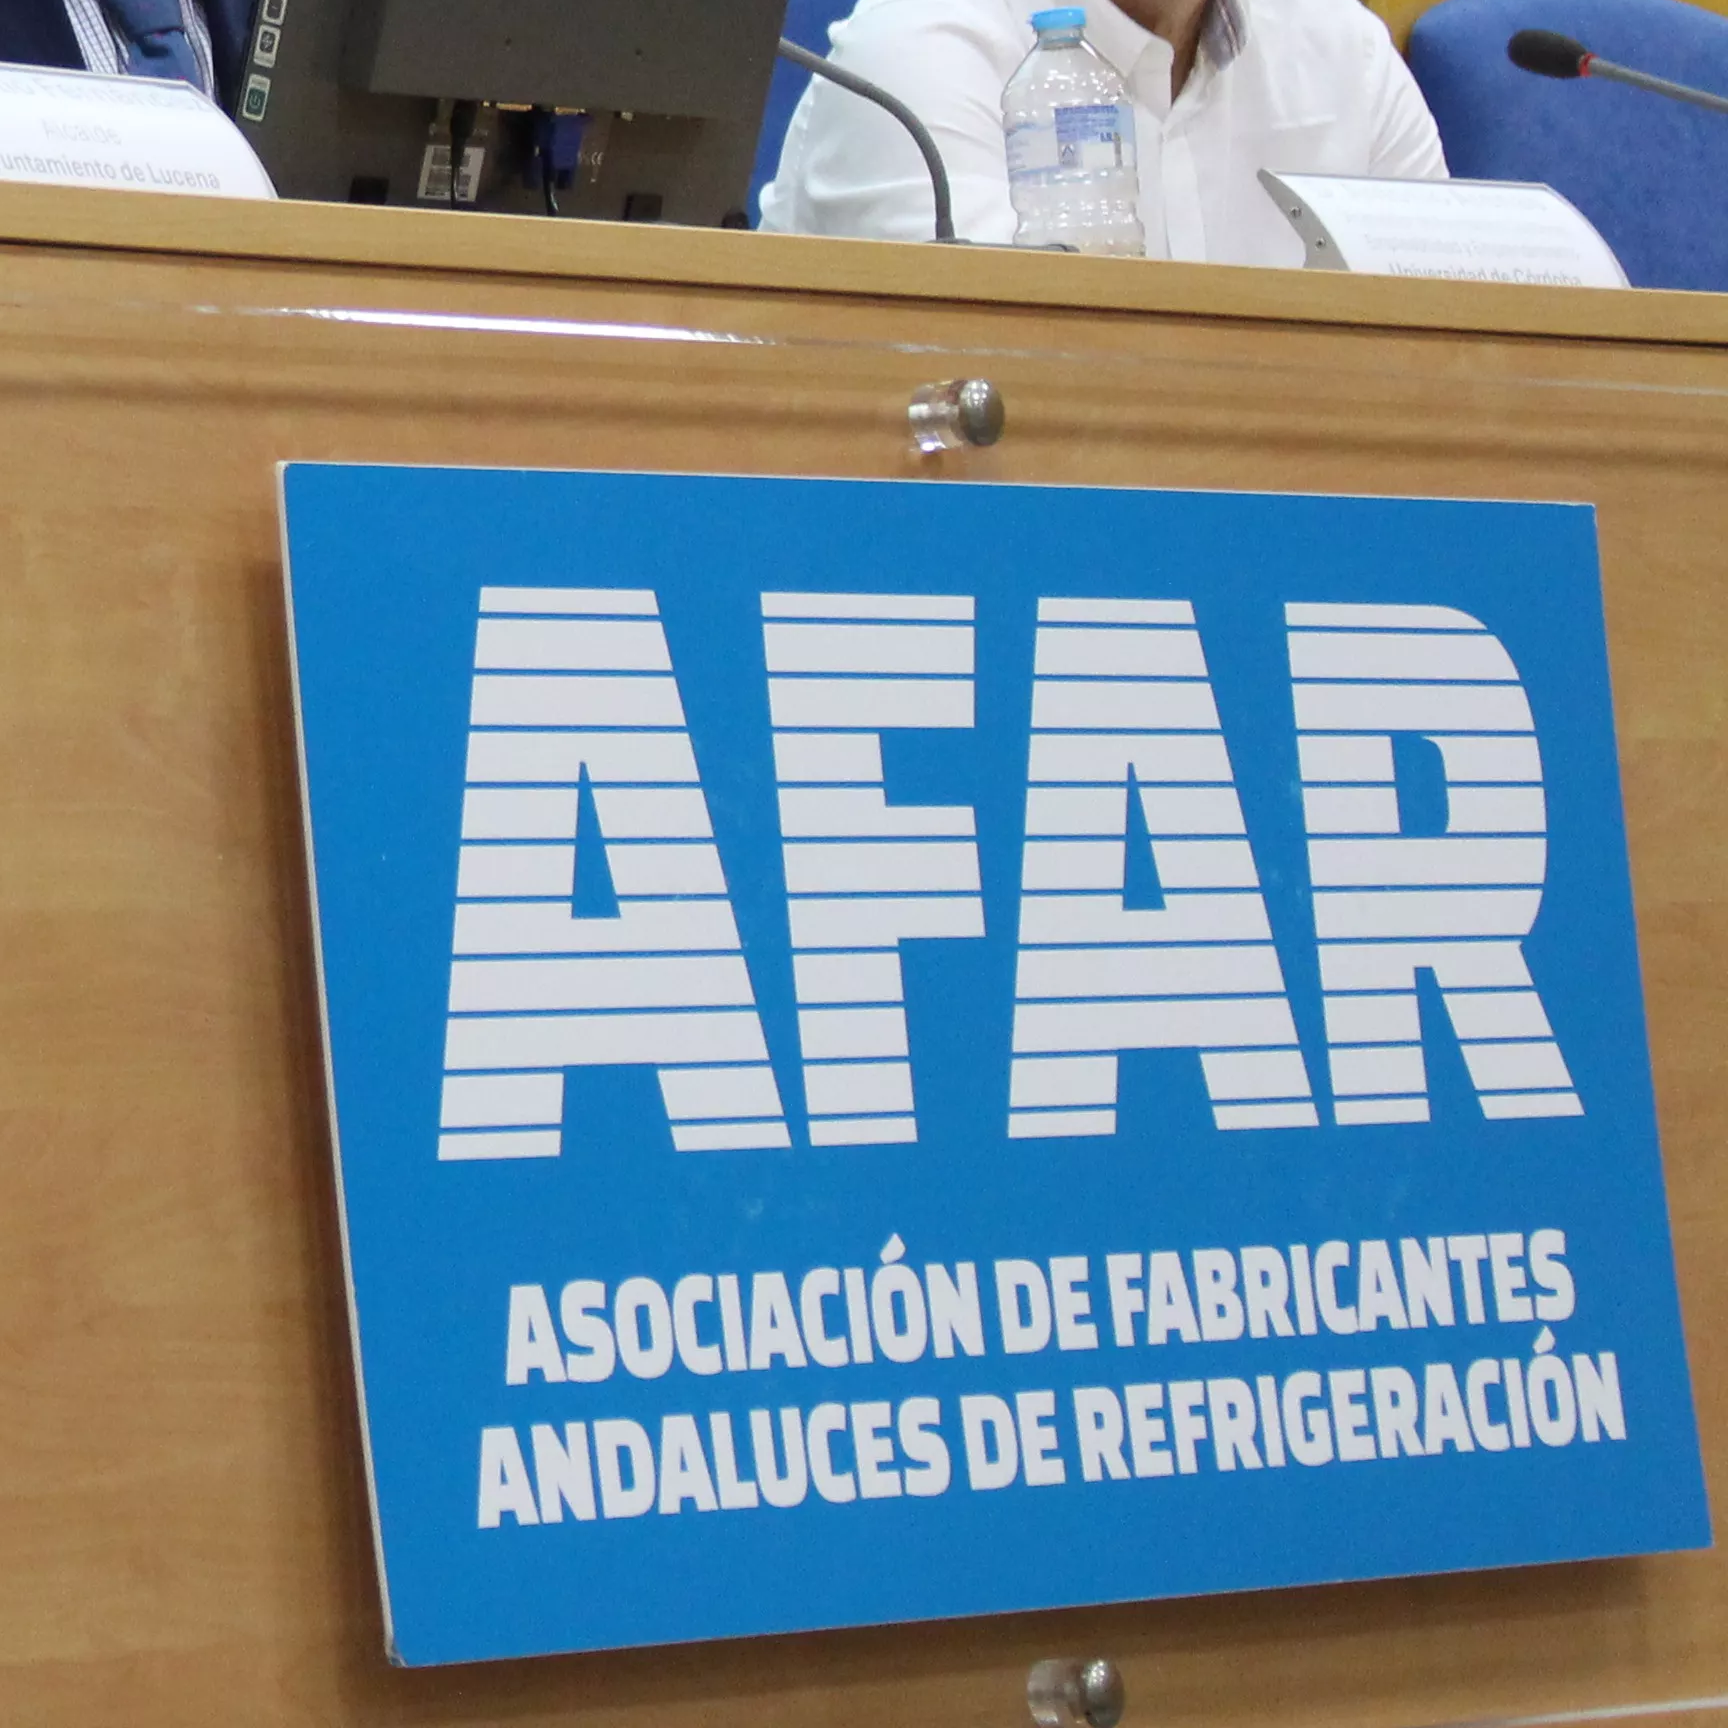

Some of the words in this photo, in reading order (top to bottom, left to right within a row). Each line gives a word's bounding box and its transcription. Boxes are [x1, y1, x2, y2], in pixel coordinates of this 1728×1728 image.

[41, 117, 122, 146] Alcalde
[120, 161, 146, 184] de
[147, 162, 221, 191] Lucena
[437, 585, 1586, 1161] AFAR
[505, 1234, 986, 1386] ASOCIACIÓN
[994, 1256, 1099, 1359] DE
[1106, 1228, 1577, 1347] FABRICANTES
[478, 1395, 952, 1528] ANDALUCES
[960, 1390, 1066, 1490] DE
[1073, 1325, 1627, 1482] REFRIGERACIÓN
